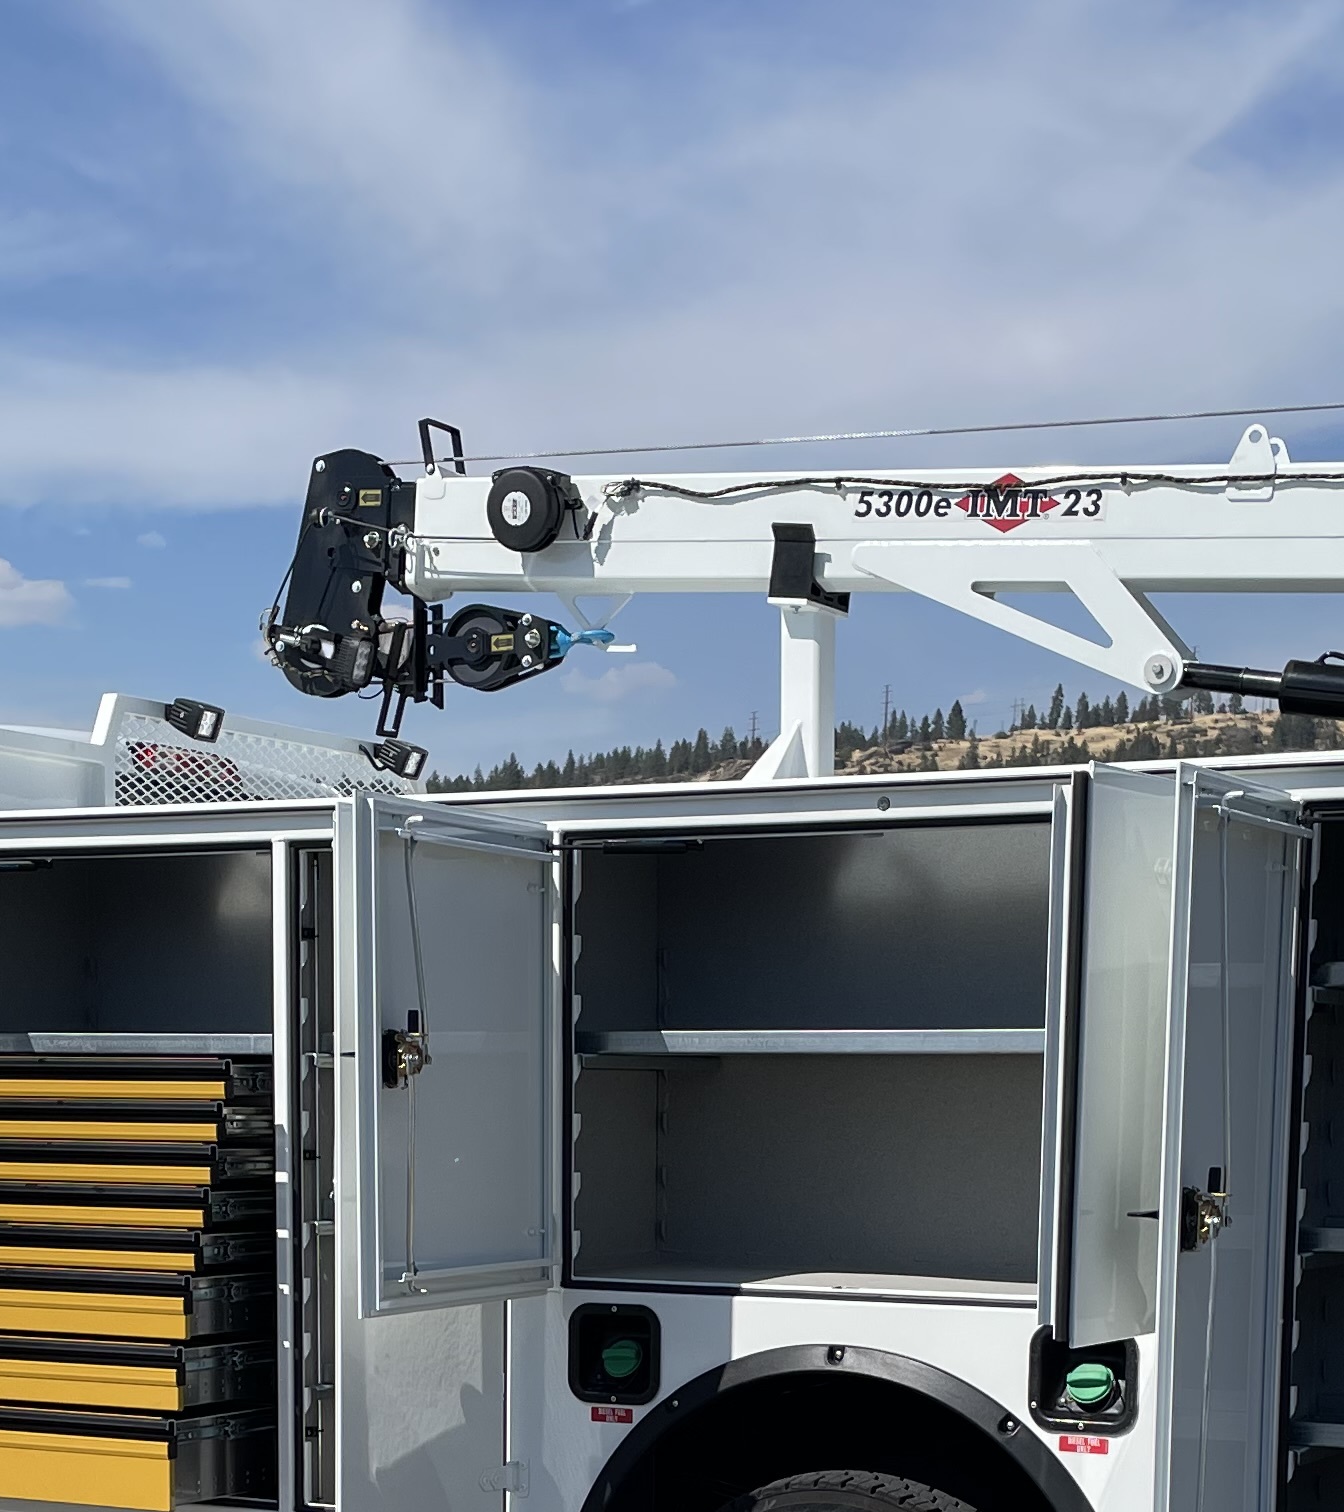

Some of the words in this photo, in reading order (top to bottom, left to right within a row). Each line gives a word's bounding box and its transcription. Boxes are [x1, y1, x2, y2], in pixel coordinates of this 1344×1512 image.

[854, 489, 952, 518] 5300e
[966, 488, 1049, 518] IMT
[1060, 488, 1103, 517] 23
